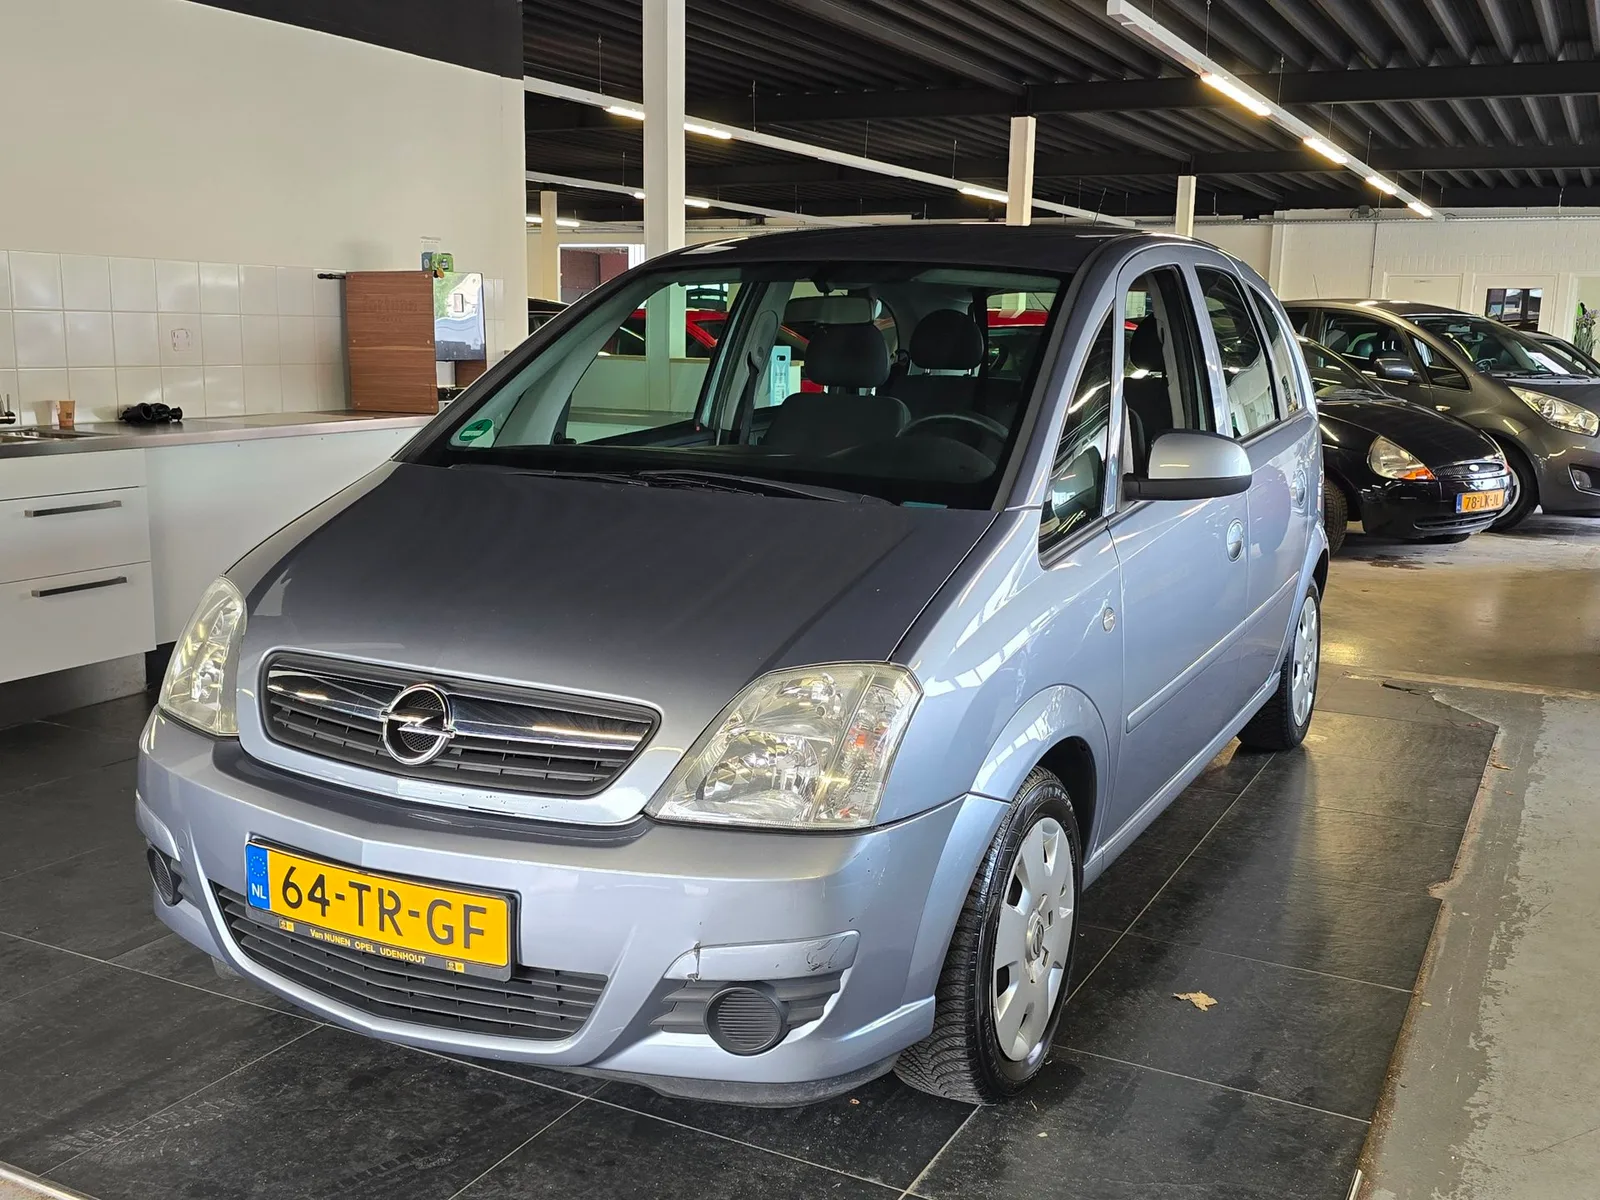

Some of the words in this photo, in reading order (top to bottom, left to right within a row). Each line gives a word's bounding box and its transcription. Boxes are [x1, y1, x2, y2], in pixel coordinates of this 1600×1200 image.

[1465, 493, 1499, 509] 78-LK-JL
[252, 883, 267, 899] NL
[282, 866, 486, 949] 64-TR-GF
[310, 929, 323, 939] Van
[324, 933, 351, 947] NUNEN
[354, 941, 376, 953] OPEL
[380, 947, 426, 964] UDENHOUT
